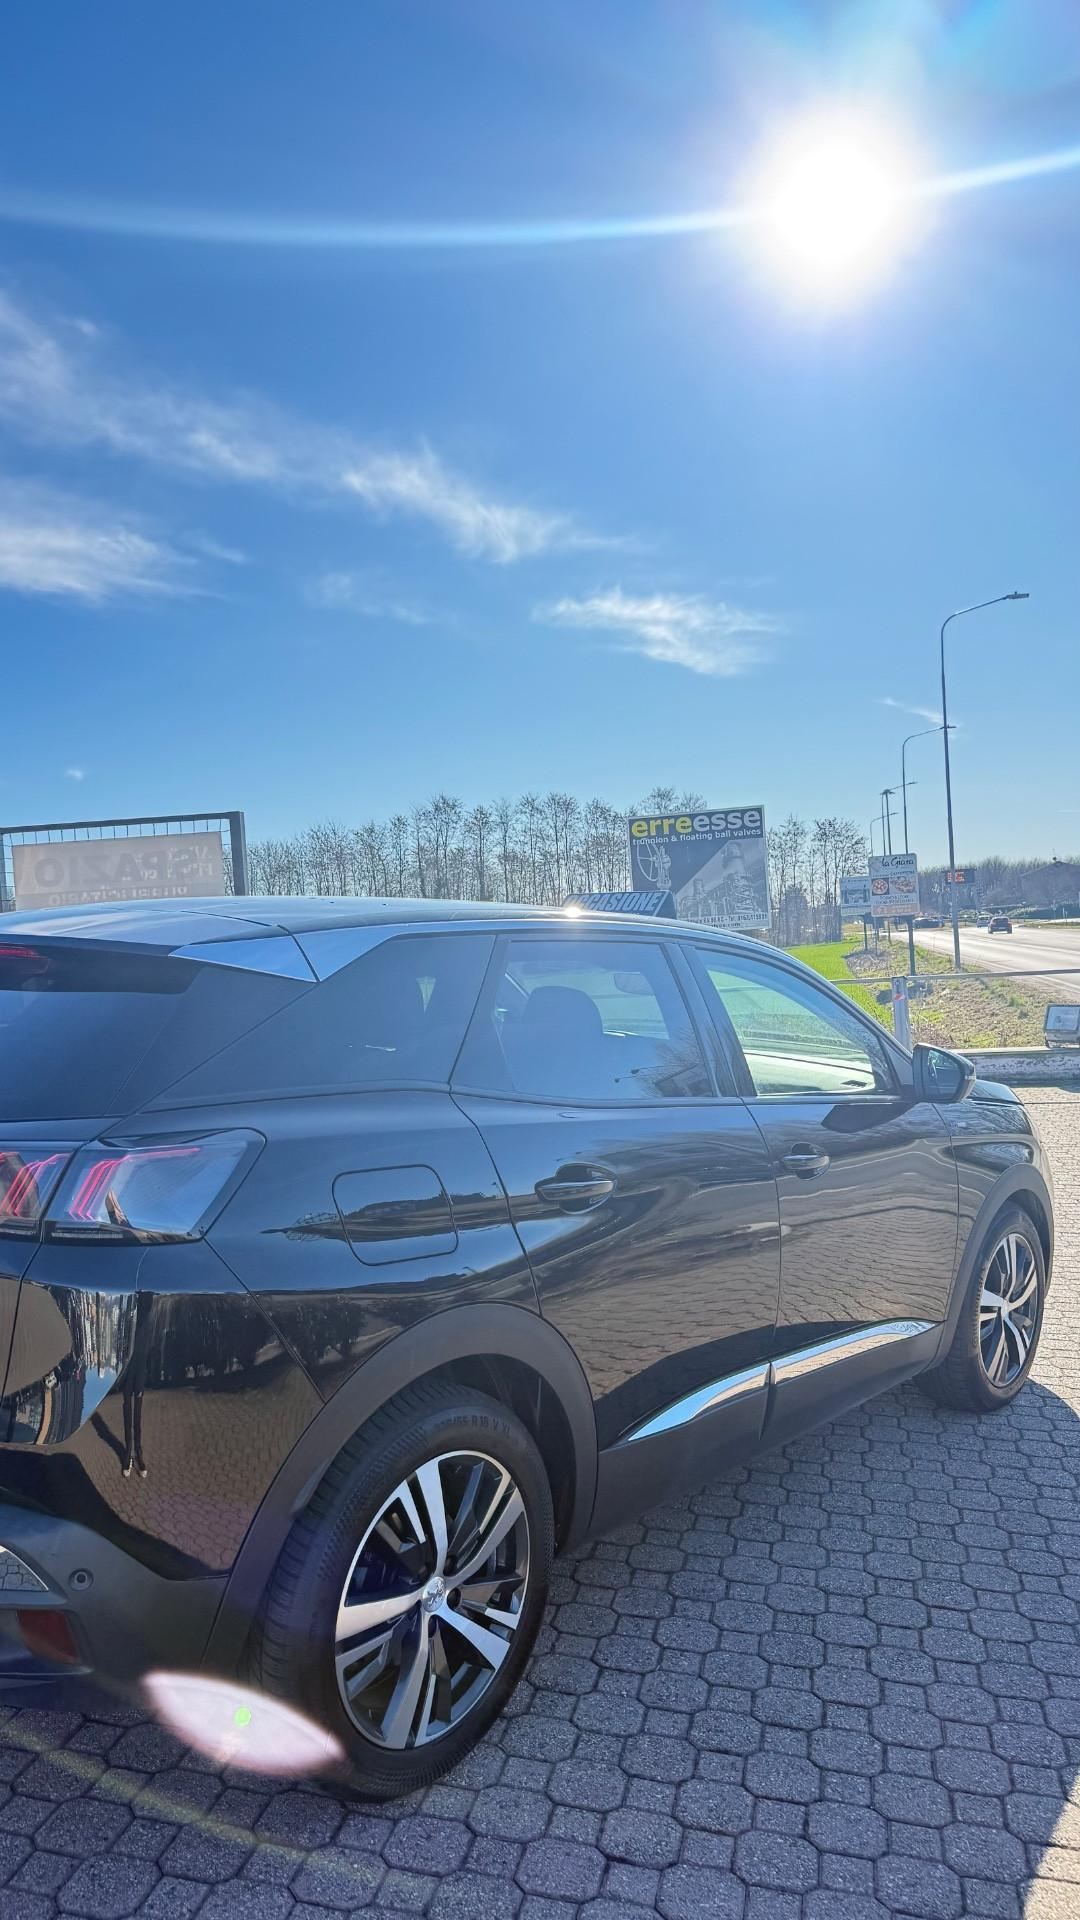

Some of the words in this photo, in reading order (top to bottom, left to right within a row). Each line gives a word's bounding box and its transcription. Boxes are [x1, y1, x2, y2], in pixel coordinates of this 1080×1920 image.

[631, 810, 761, 837] erreesse
[680, 832, 713, 841] floating
[715, 830, 731, 838] ball
[733, 828, 761, 837] valves
